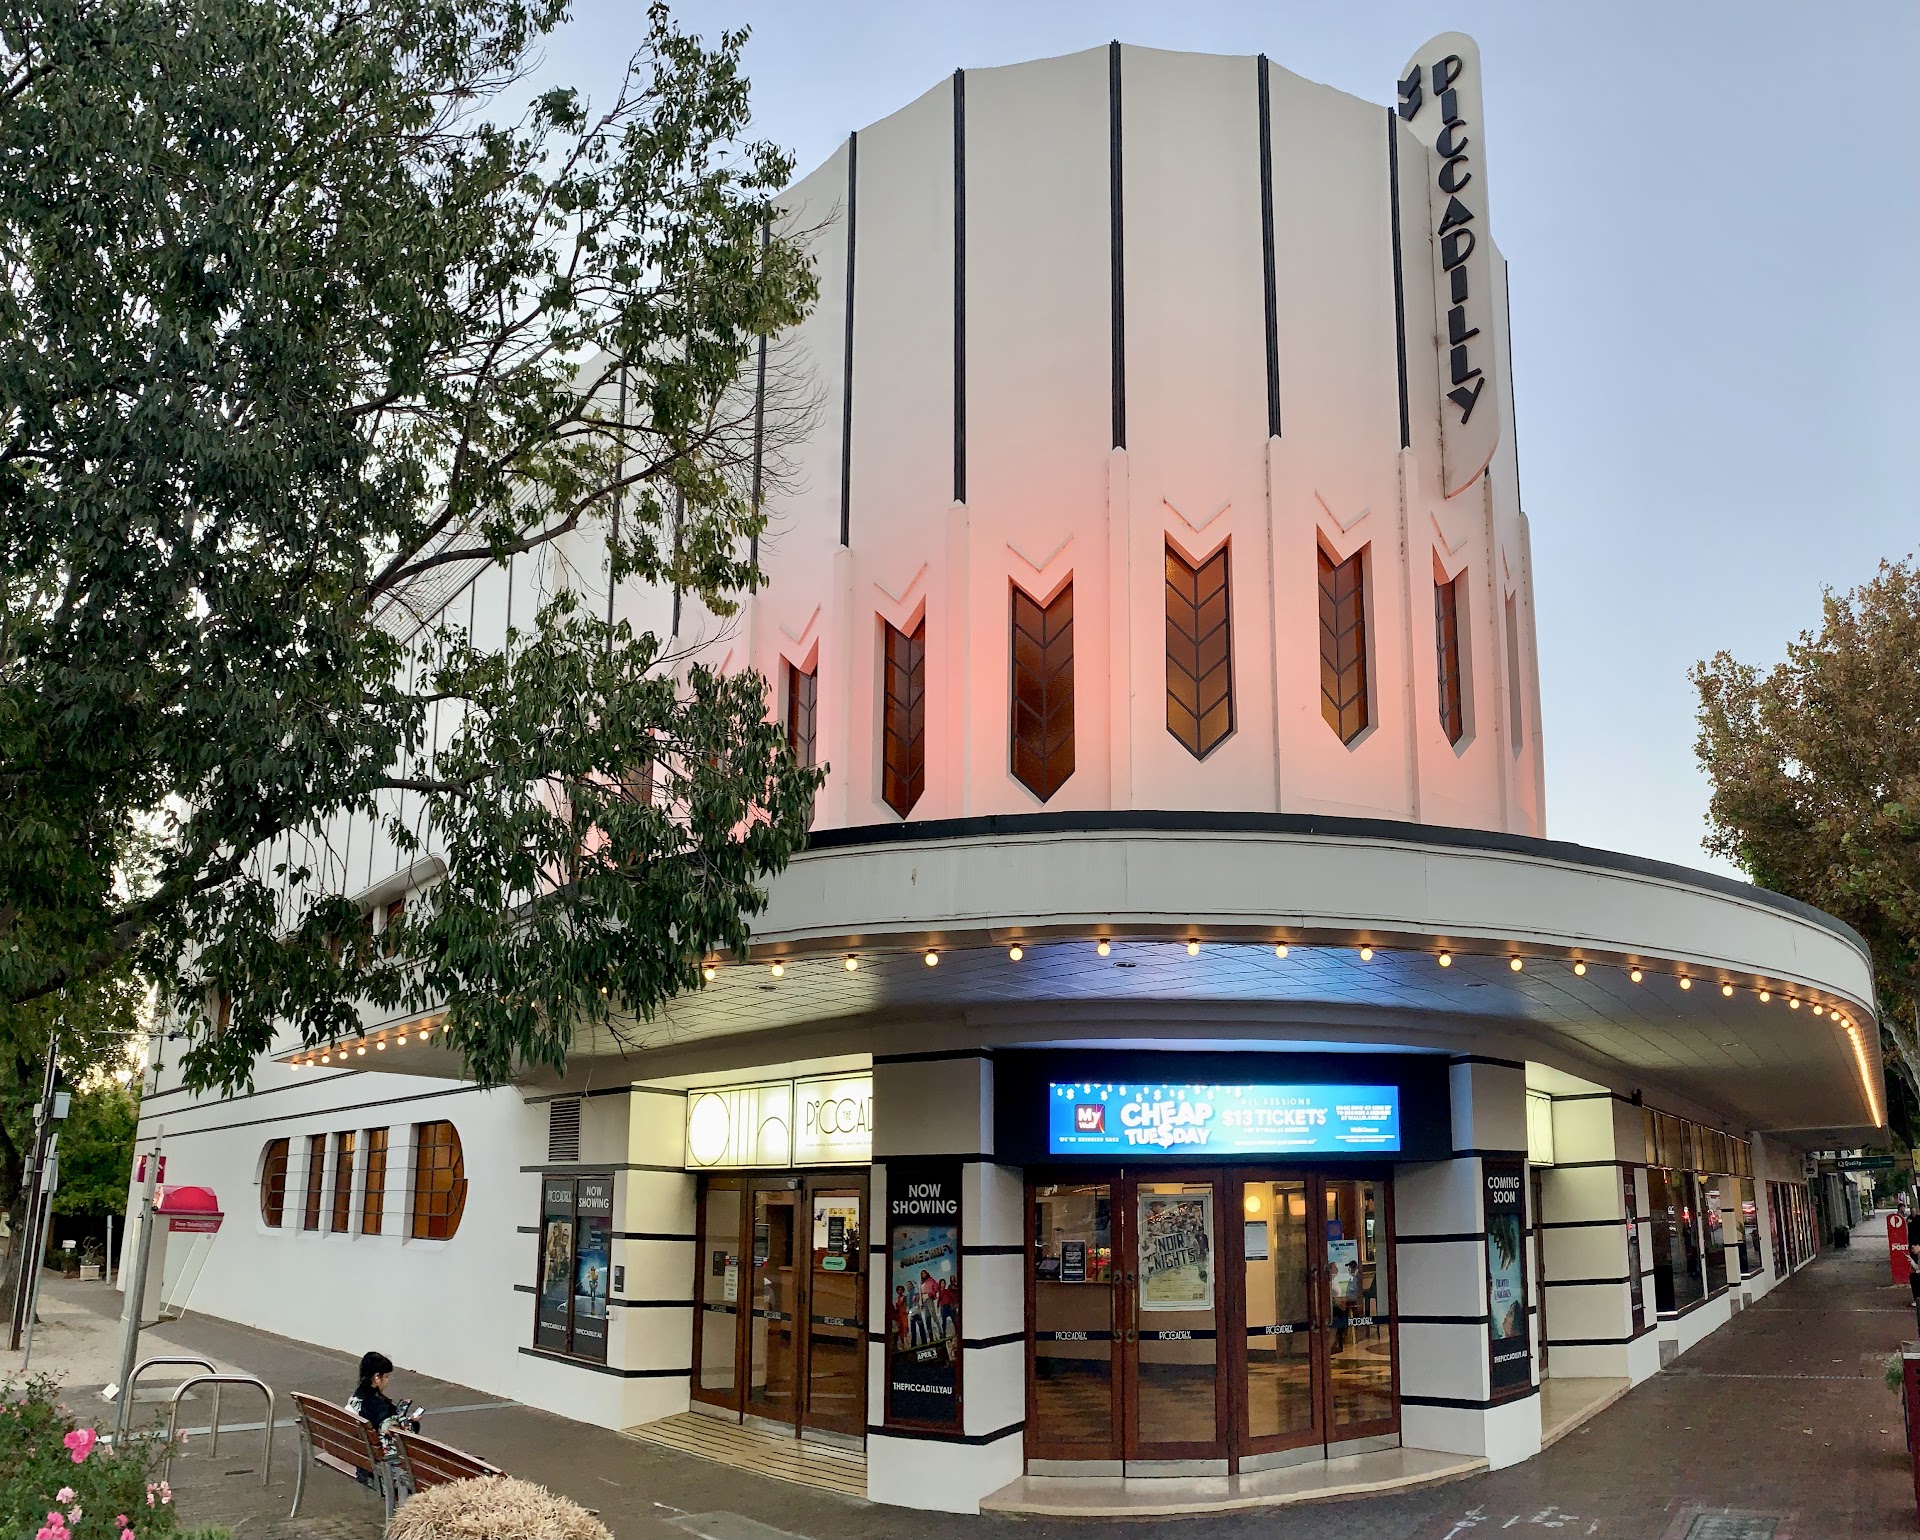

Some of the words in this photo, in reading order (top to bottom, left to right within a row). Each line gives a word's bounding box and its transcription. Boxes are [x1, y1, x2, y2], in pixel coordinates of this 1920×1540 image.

[1431, 54, 1485, 425] PICCADILLY
[1263, 1097, 1311, 1105] SESSIONS
[1078, 1108, 1101, 1126] My
[1120, 1101, 1213, 1127] CHEAP
[1222, 1108, 1253, 1127] $13
[1488, 1176, 1520, 1189] COMING
[586, 1186, 602, 1196] NOW
[908, 1184, 942, 1197] NOW
[1493, 1190, 1516, 1203] SOON
[578, 1197, 610, 1209] SHOWING
[892, 1200, 958, 1214] SHOWING
[1157, 1233, 1185, 1253] NOIR
[1153, 1248, 1196, 1270] NIGHTS
